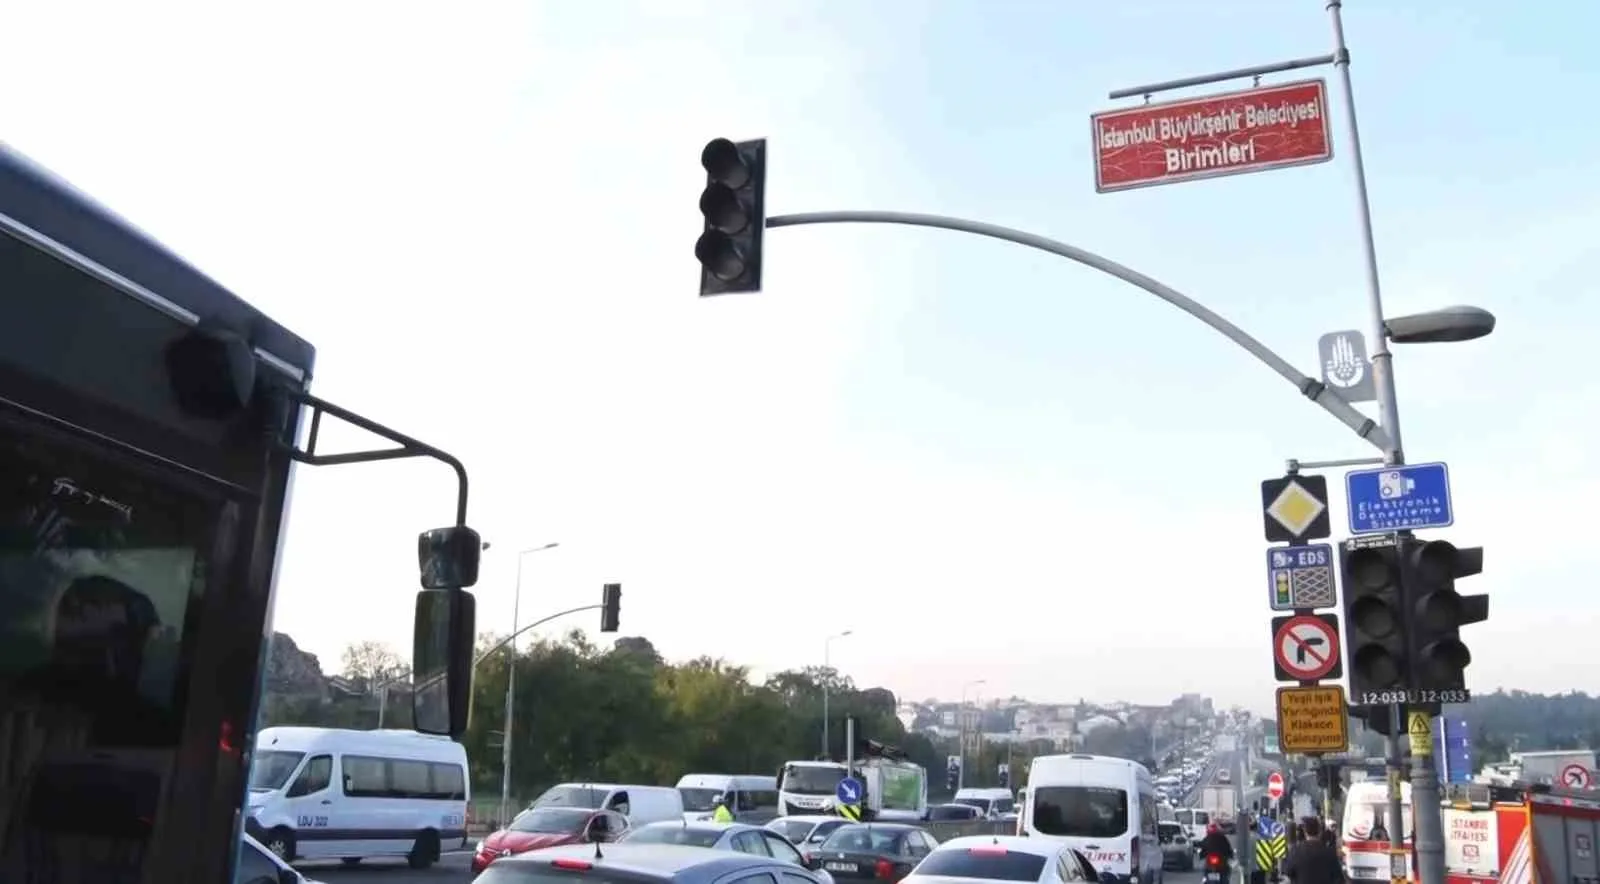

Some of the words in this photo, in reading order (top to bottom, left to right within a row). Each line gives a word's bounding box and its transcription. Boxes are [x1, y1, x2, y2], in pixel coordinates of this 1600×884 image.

[1244, 96, 1320, 129] Belediyesi
[1165, 138, 1256, 171] Birimleri
[1298, 551, 1326, 565] EDS
[1362, 690, 1406, 705] 12-033
[1420, 690, 1466, 704] 12-033
